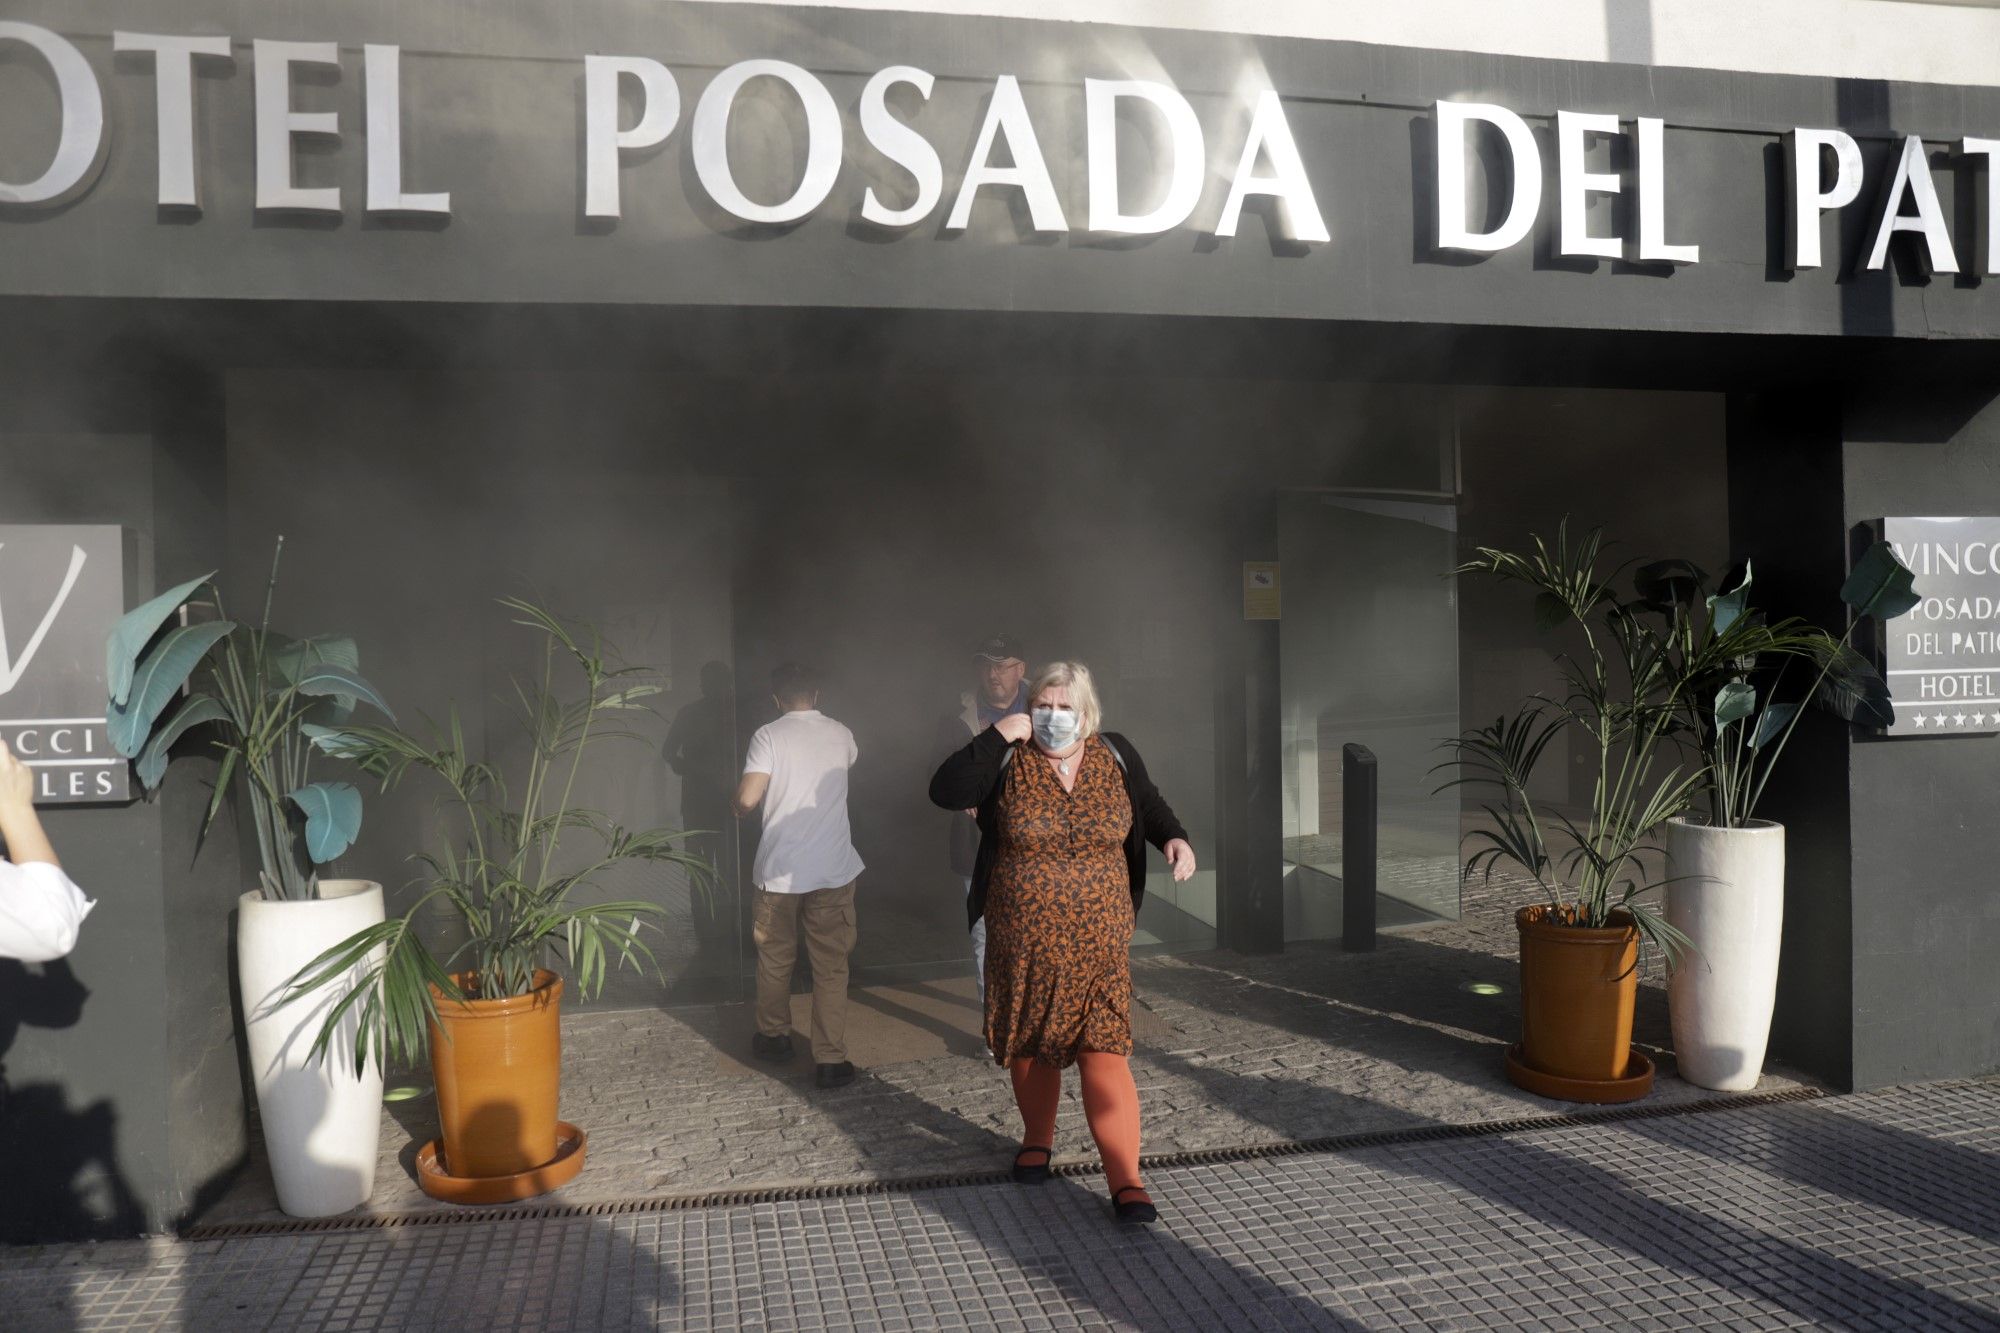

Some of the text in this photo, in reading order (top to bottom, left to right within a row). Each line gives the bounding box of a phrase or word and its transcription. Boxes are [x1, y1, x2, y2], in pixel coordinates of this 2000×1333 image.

[0, 21, 450, 211] OTEL
[585, 54, 1331, 242] POSADA
[1436, 99, 1700, 263] DEL
[1906, 631, 2000, 656] DEL PATI
[1920, 674, 1995, 698] HOTEL
[10, 728, 93, 755] CCI
[40, 770, 113, 797] LES
